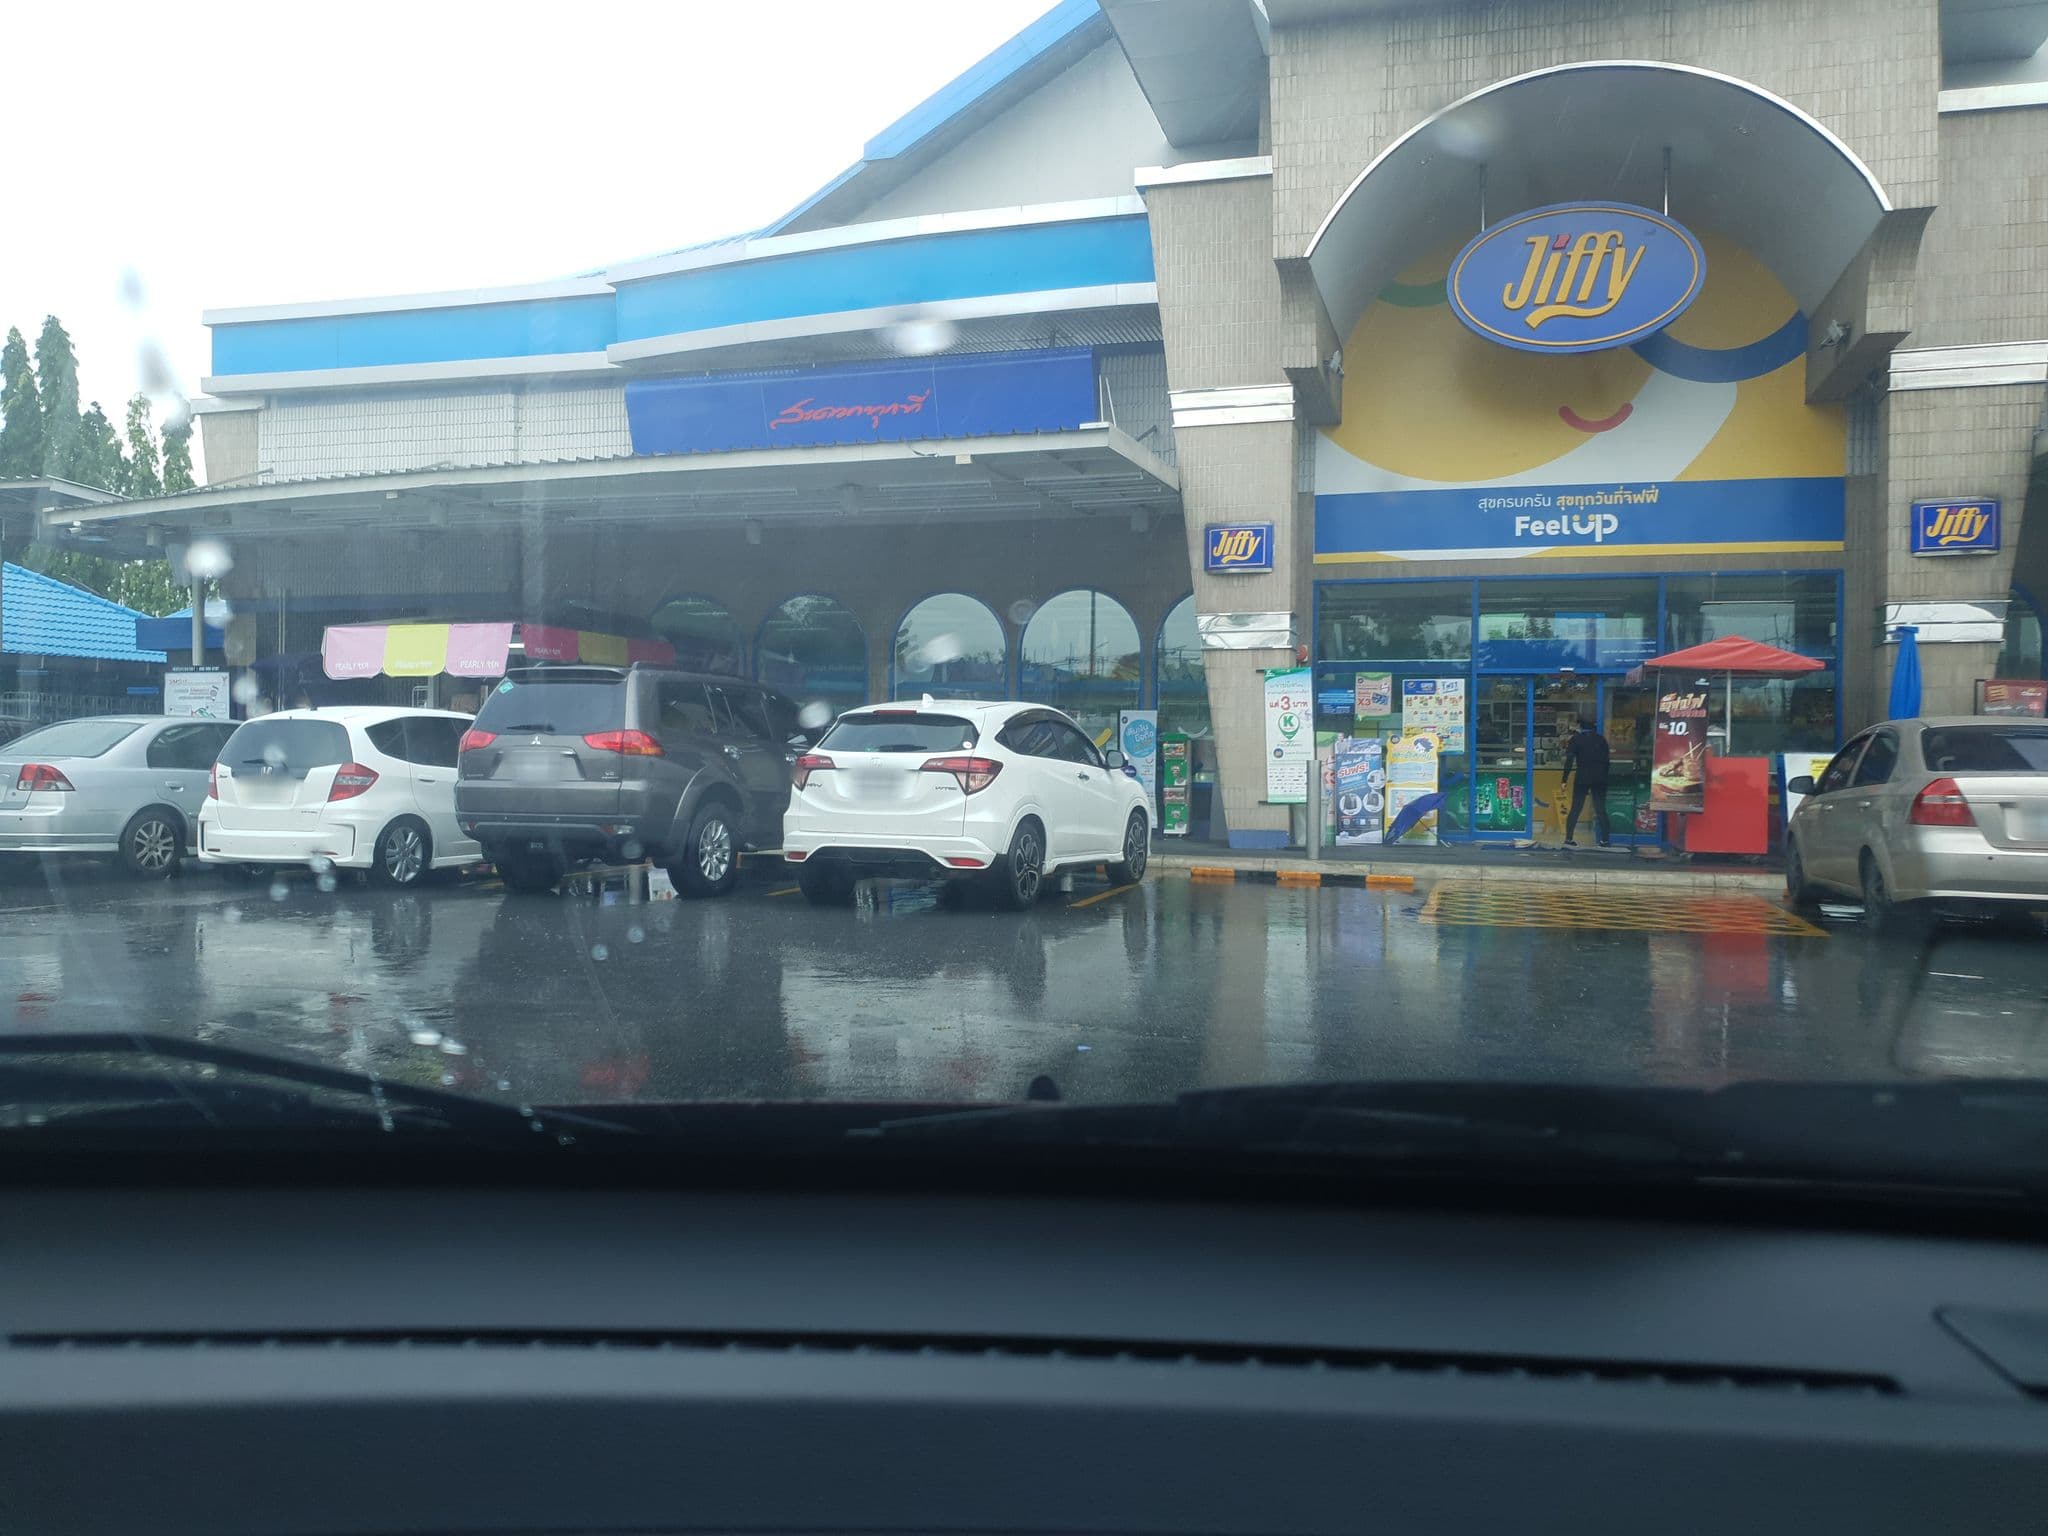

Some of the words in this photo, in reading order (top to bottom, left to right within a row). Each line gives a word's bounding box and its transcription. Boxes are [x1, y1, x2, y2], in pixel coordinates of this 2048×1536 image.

[1502, 230, 1646, 330] Jiffy
[1478, 493, 1551, 512] สุขครบครัน
[1515, 515, 1570, 537] Feel
[1926, 507, 1990, 546] Jiffy
[1212, 530, 1262, 564] Jiffy
[1280, 695, 1291, 711] 3
[1283, 715, 1294, 727] K
